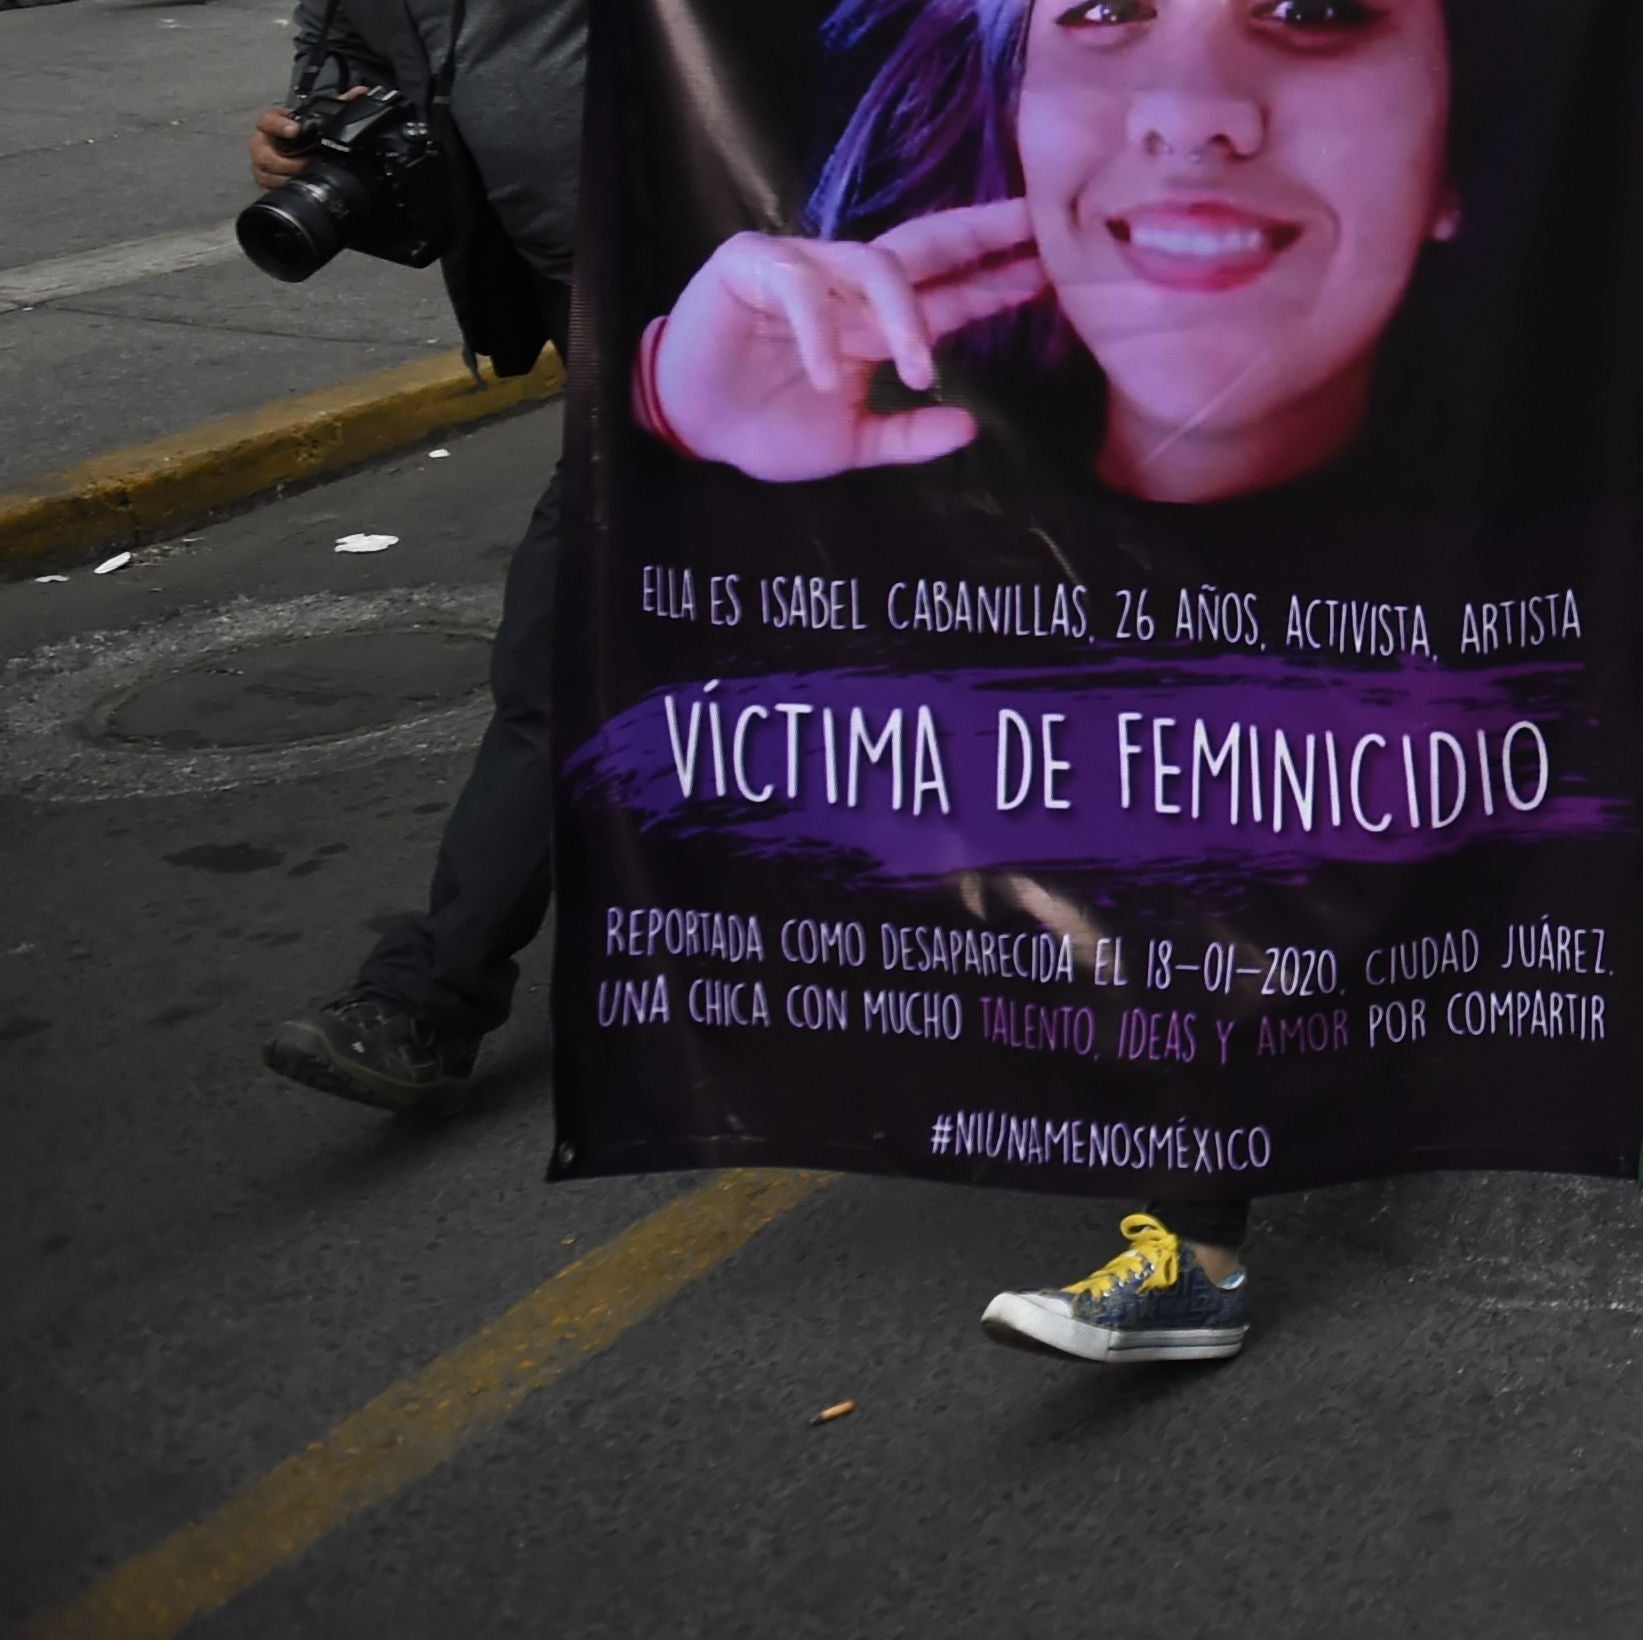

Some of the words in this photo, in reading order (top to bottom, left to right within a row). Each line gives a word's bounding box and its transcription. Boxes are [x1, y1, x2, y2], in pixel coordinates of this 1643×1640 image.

[642, 564, 698, 621] ELLA
[710, 573, 742, 626] ES
[760, 574, 868, 631] ISABEL
[1114, 587, 1156, 642] 26
[1460, 587, 1583, 656] ARTISTA
[663, 677, 951, 818] VÍCTIMA
[996, 706, 1074, 814] DE
[1117, 711, 1551, 834] FEMINICIDIO
[605, 905, 765, 962] REPORTADA
[780, 917, 867, 968] COMO
[880, 922, 1076, 985] DESAPARECIDA
[1093, 936, 1128, 988] EL
[1365, 928, 1480, 987] CIUDAD
[1500, 912, 1617, 978] JUÁREZ.
[598, 973, 672, 1029] UNA
[688, 977, 771, 1028] CHICA
[786, 982, 849, 1032] CON
[863, 989, 964, 1042] MUCHO
[1117, 1007, 1199, 1064] IDEAS
[1216, 1019, 1236, 1066] Y
[1256, 1007, 1350, 1058] AMOR
[1368, 996, 1427, 1050] POR
[1446, 987, 1606, 1044] COMPARTIR
[930, 1108, 1272, 1175] #NIUNAMENOSMÉXICO
